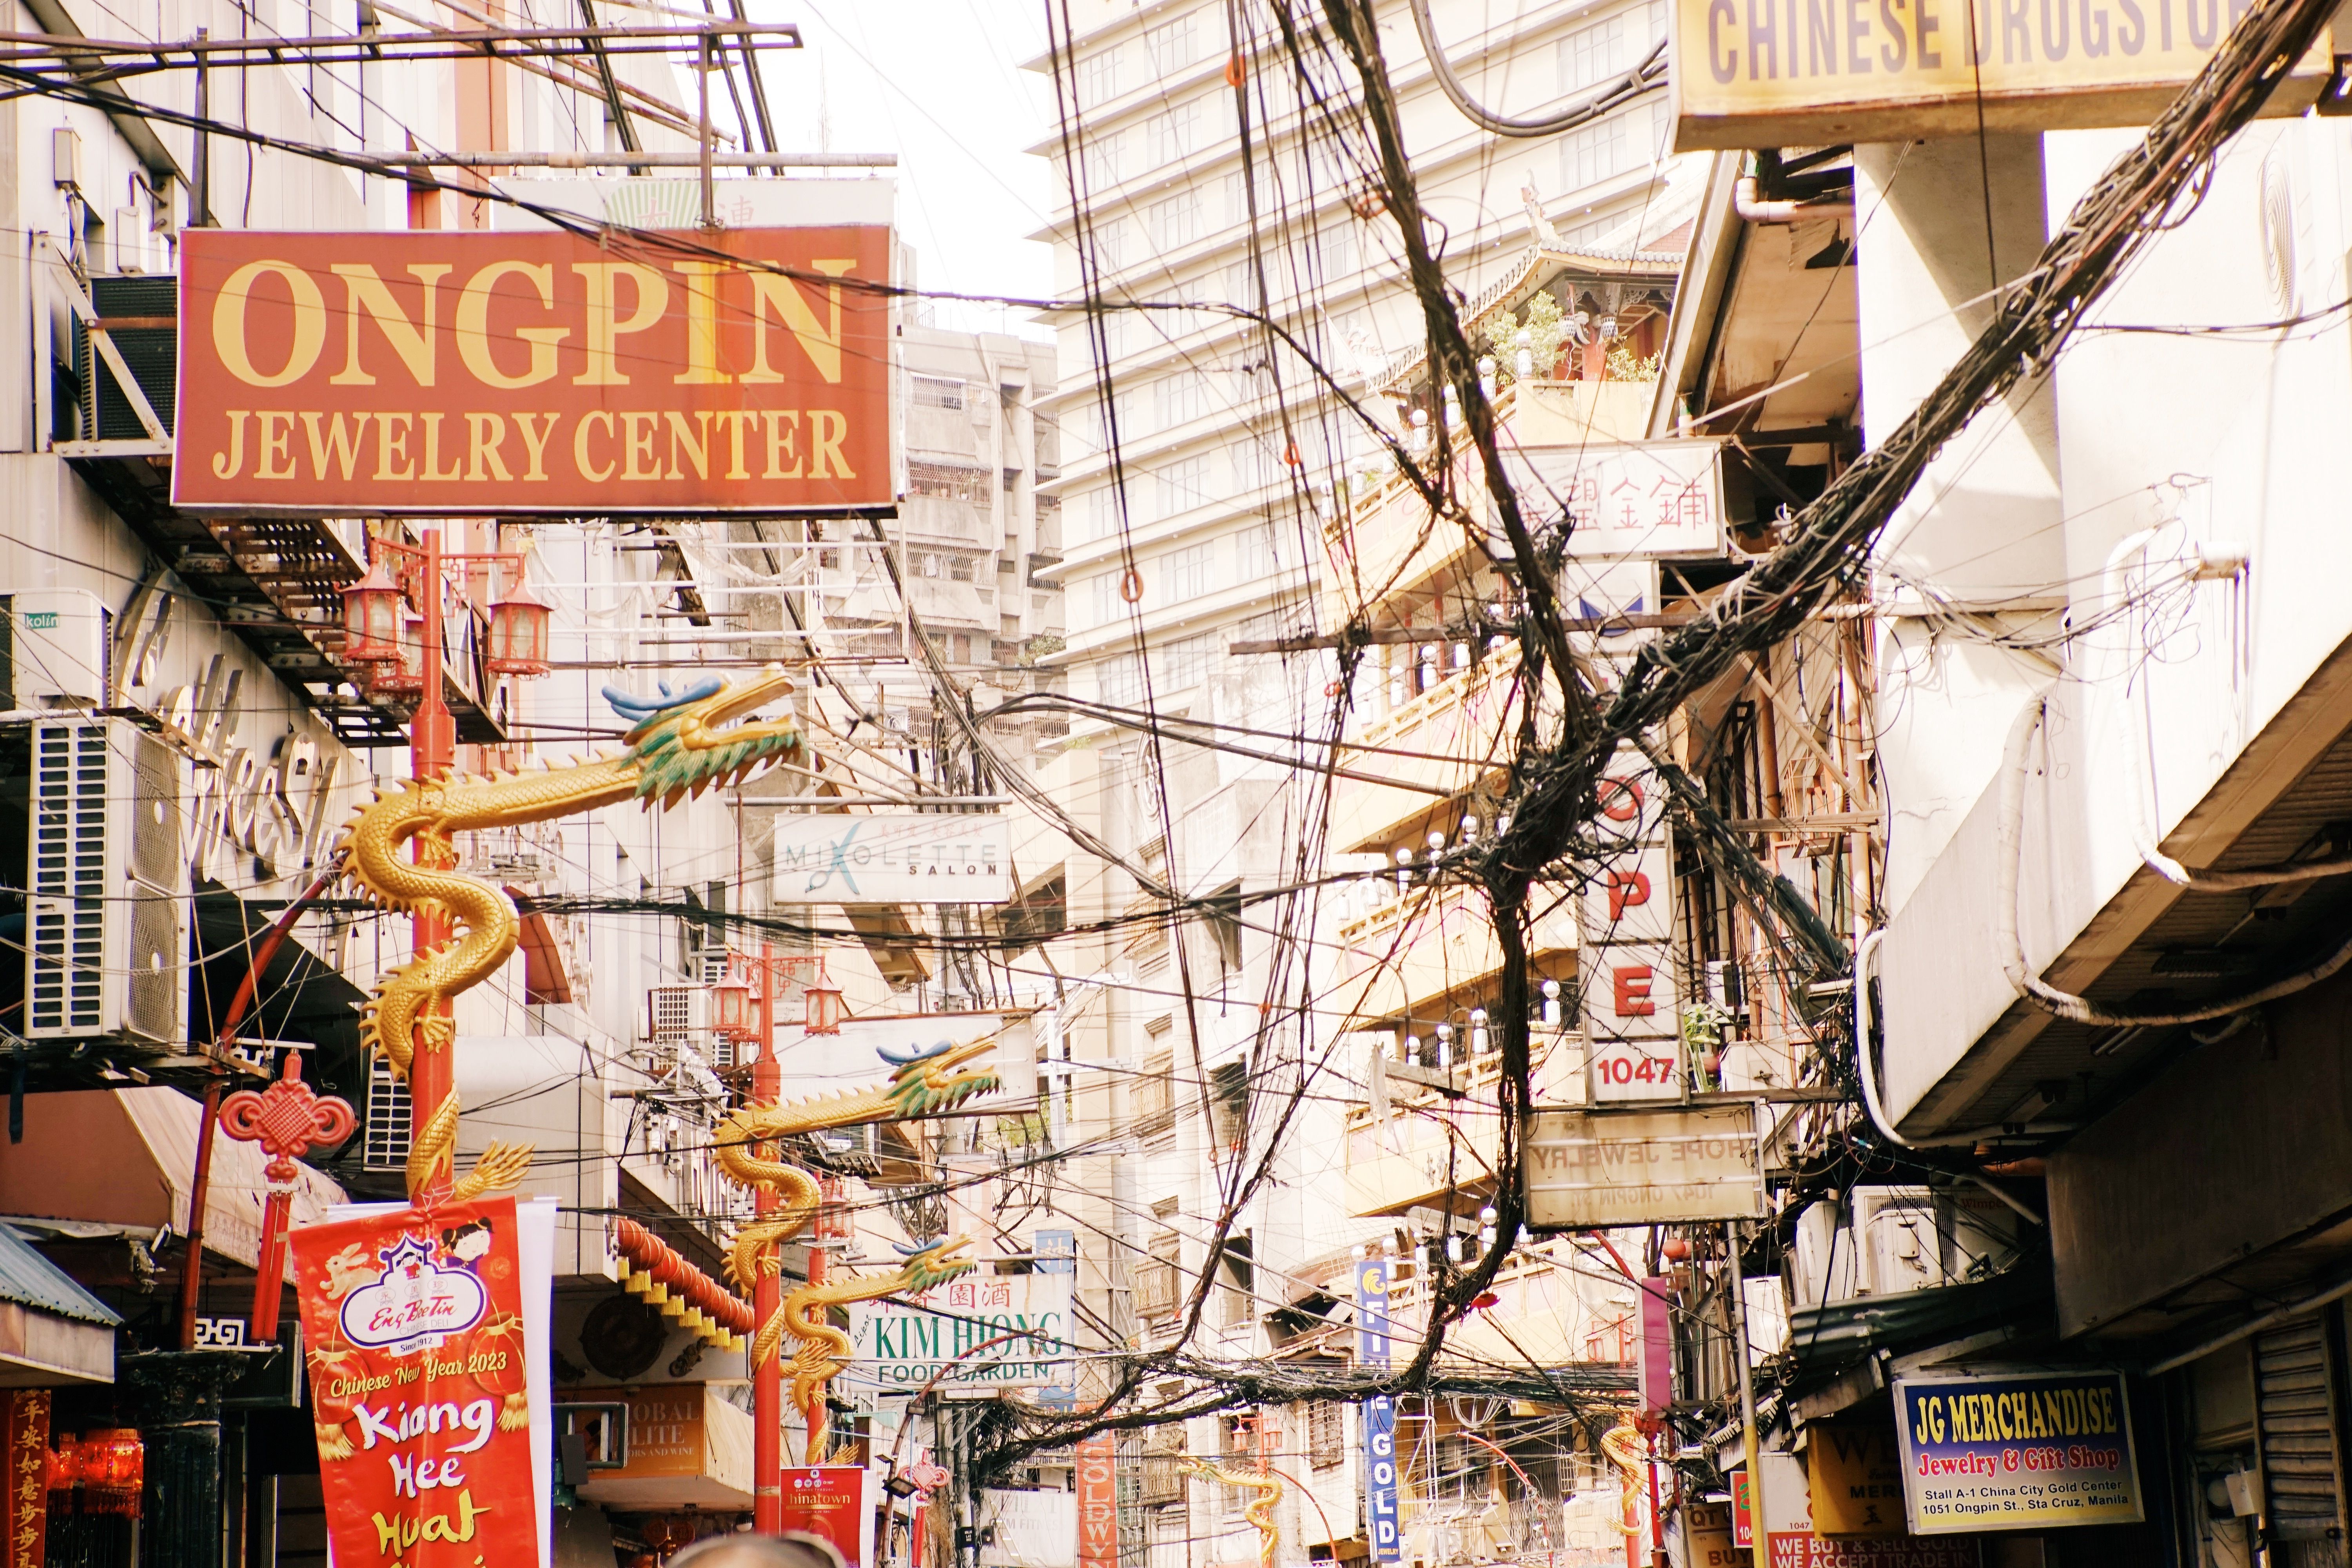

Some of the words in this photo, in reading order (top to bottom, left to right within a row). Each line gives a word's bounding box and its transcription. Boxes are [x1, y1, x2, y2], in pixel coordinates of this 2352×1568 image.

[1708, 0, 1942, 84] CHINESE
[213, 259, 857, 389] ONGPIN
[213, 412, 561, 482] JEWELRY
[574, 410, 856, 483] CENTER
[26, 614, 59, 627] kolin
[909, 865, 996, 875] SALON
[1598, 1057, 1675, 1084] 1047
[368, 1307, 405, 1332] Eng
[404, 1299, 429, 1323] Bee
[429, 1296, 458, 1316] Tin
[399, 1320, 428, 1336] CHINESE
[430, 1319, 448, 1328] DELI
[873, 1316, 940, 1359] KIM
[953, 1311, 1062, 1358] HIONG
[400, 1342, 417, 1352] Since
[417, 1337, 433, 1347] 1912
[331, 1373, 392, 1398] Chinese
[394, 1365, 420, 1386] New
[424, 1357, 464, 1383] Year
[468, 1351, 507, 1374] 2023
[955, 1361, 1049, 1382] GARDEN
[633, 1401, 700, 1421] OBAL
[1916, 1396, 1945, 1445] JG
[1948, 1387, 2117, 1443] MERCHANDISE
[1918, 1452, 1998, 1478] Jewelry
[2003, 1448, 2019, 1472] &
[2024, 1446, 2065, 1471] Gift
[2069, 1445, 2120, 1472] Shop
[388, 1452, 466, 1499] Hee
[1372, 1432, 1396, 1544] GOLD
[1850, 1485, 1903, 1498] MER
[1925, 1489, 1953, 1500] Stall
[1956, 1488, 1976, 1499] A-1
[1980, 1486, 2016, 1497] China
[2020, 1485, 2044, 1497] City
[2048, 1481, 2078, 1494] Gold
[2081, 1479, 2122, 1491] Center
[1923, 1503, 1950, 1515] 1051
[1955, 1502, 2000, 1515] Ongpin
[2029, 1498, 2048, 1509] Sta
[2052, 1496, 2084, 1508] Cruz,
[2088, 1494, 2128, 1506] Manila
[371, 1489, 492, 1557] Huat
[1708, 1549, 1750, 1566] BUY
[1776, 1539, 1804, 1555] WE
[1810, 1540, 1843, 1554] BUY
[1776, 1555, 1803, 1568] WE
[1809, 1553, 1880, 1568] ACCEPT
[1885, 1552, 1947, 1568] TRADE
